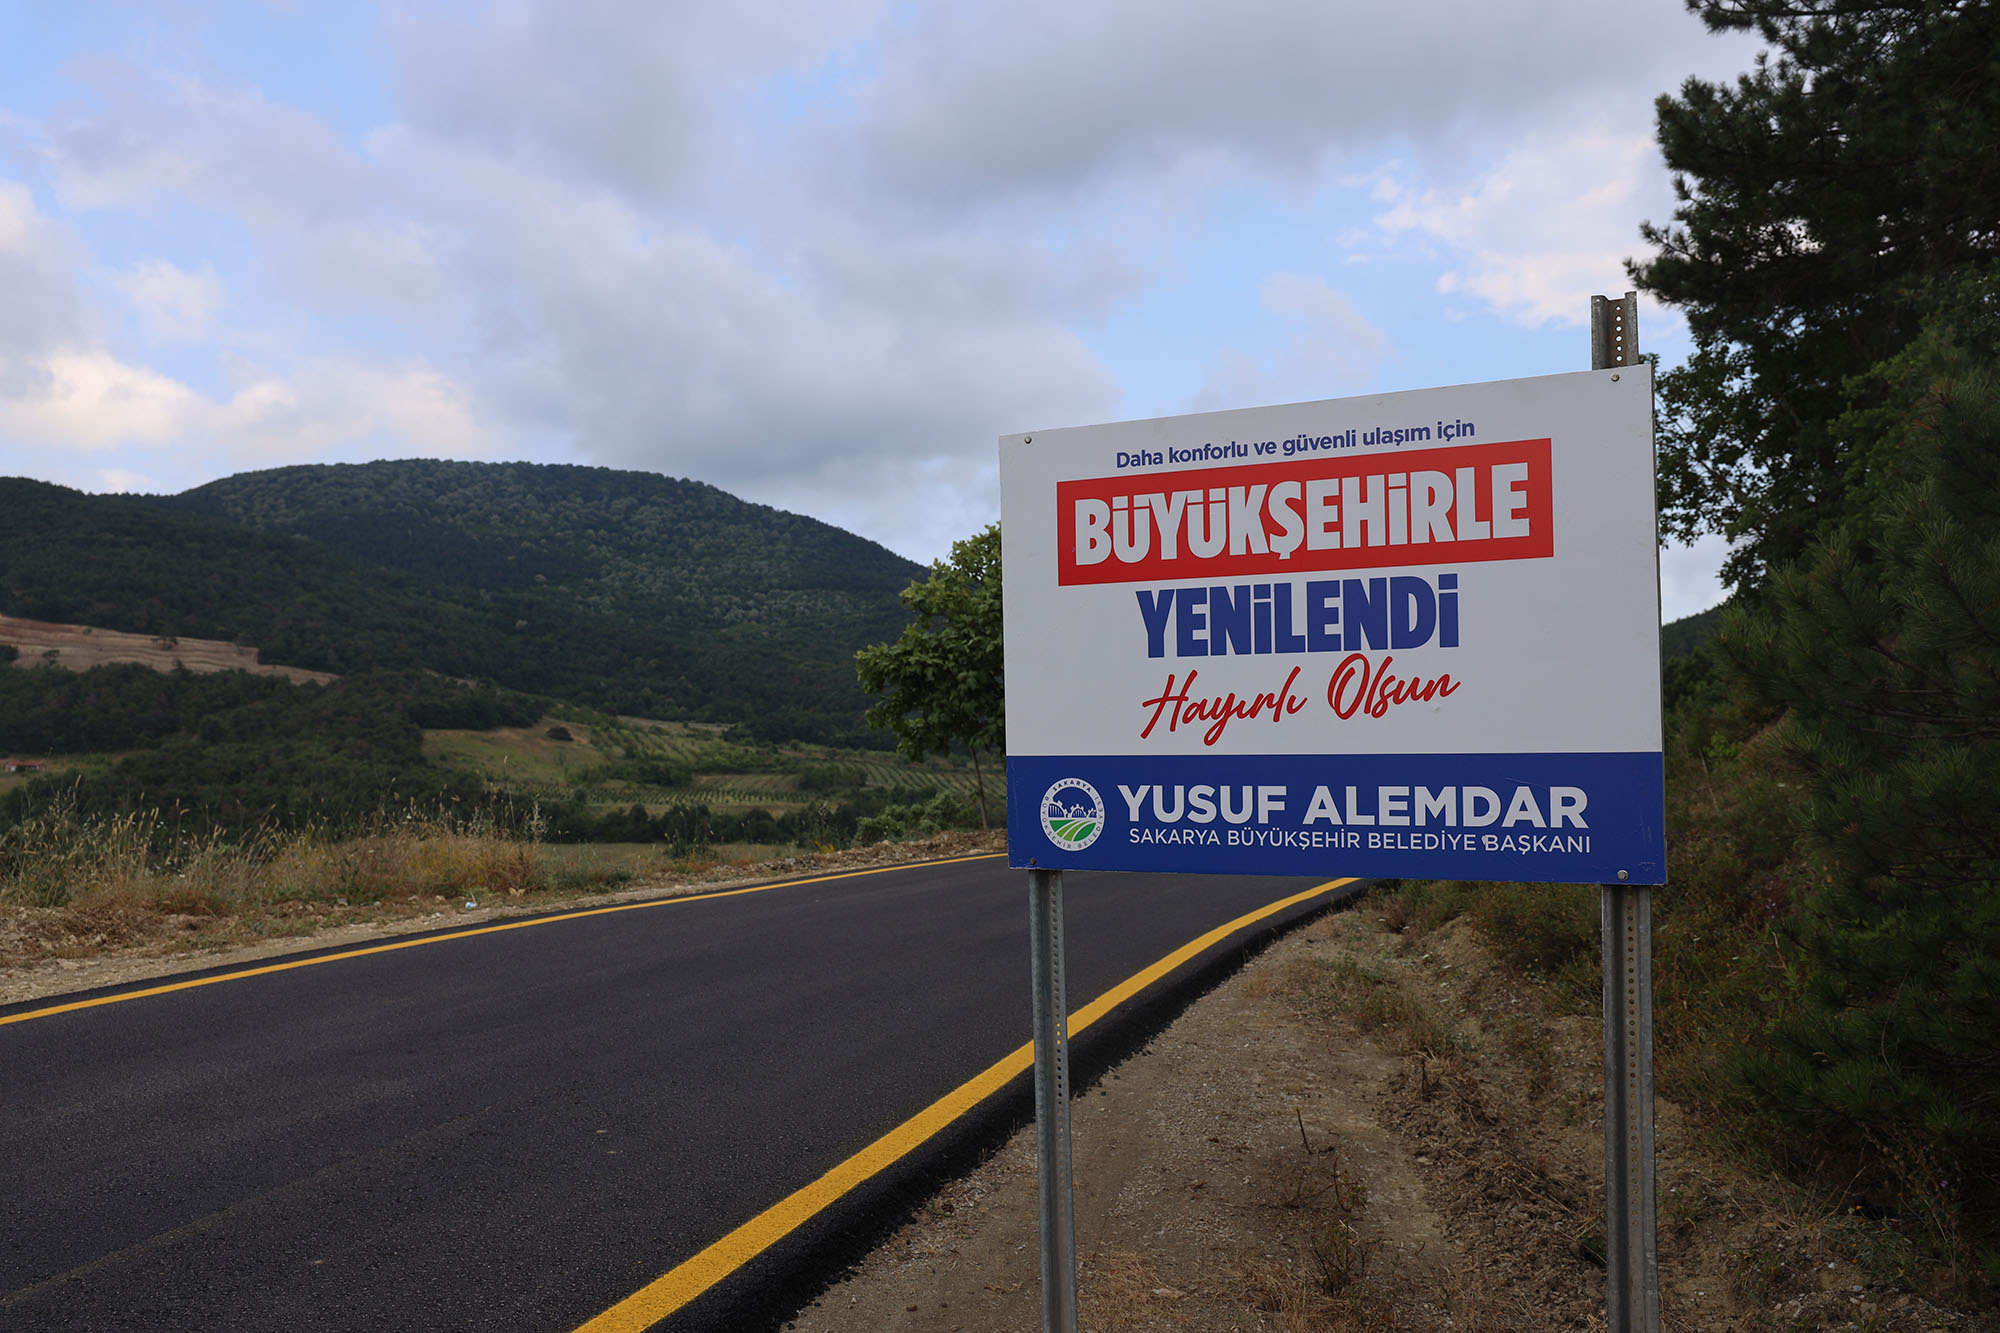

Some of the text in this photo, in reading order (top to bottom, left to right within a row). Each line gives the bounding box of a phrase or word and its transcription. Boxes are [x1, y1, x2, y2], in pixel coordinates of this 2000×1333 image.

[1116, 419, 1476, 468] Daha konforlu ve güvenli ulaşım için
[1074, 461, 1530, 566] BÜYÜKŞEHİRLE
[1135, 572, 1460, 659] YENİLENDİ
[1140, 652, 1462, 747] Hayırlı Olsun
[1117, 784, 1590, 829] YUSUF ALEMDAR
[1129, 826, 1591, 855] SAKARYA BÜYÜKŞEHİR BELEDİYE BAŞKANI
